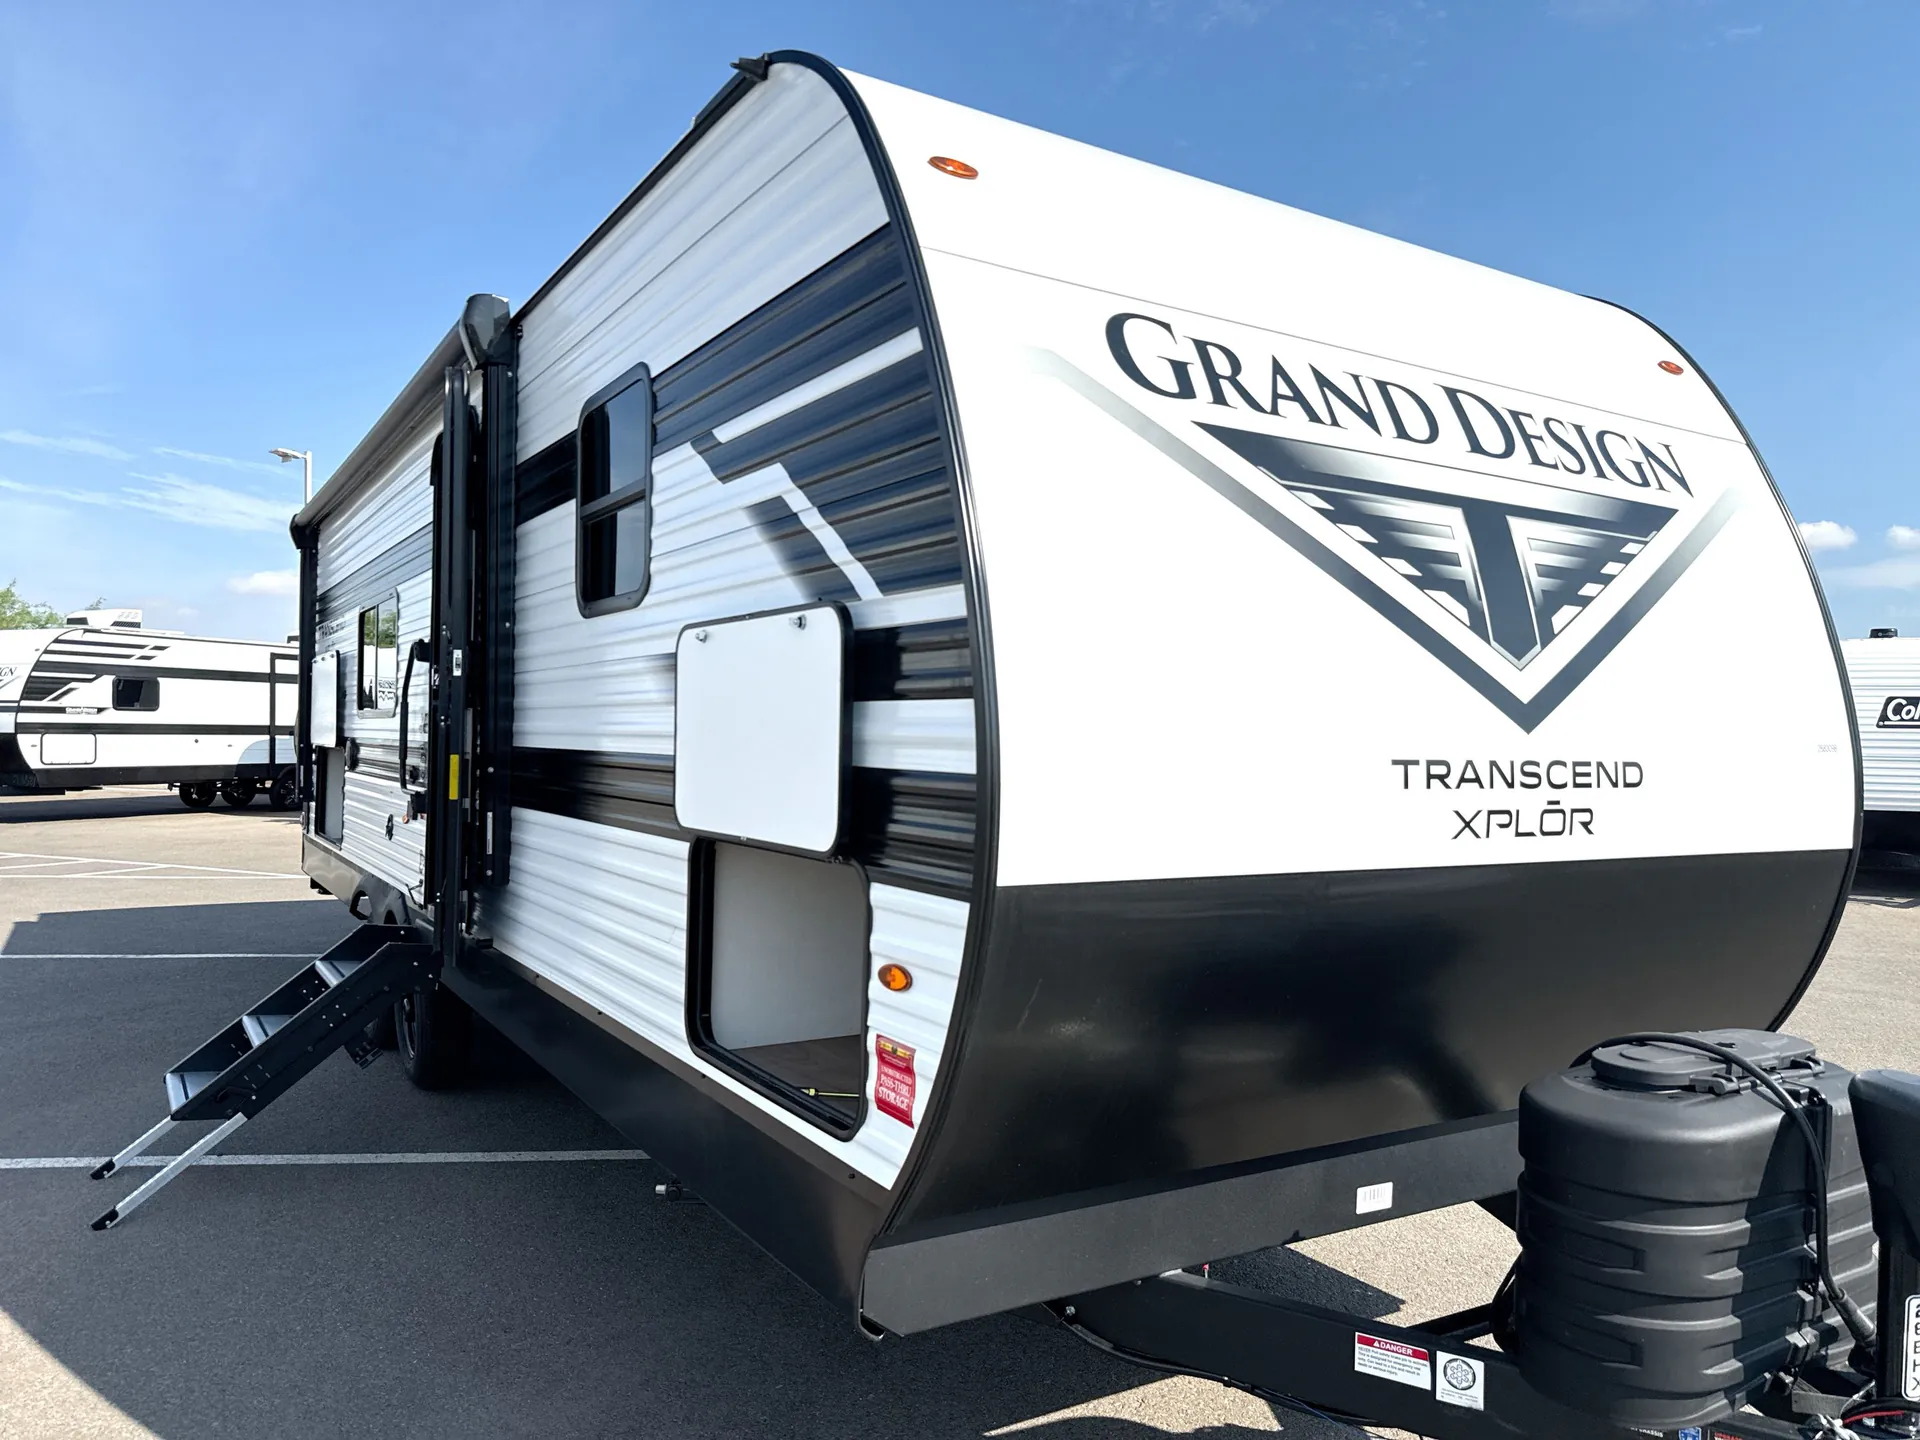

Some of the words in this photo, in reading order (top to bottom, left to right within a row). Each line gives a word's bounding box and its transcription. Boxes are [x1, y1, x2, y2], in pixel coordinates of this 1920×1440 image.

[1105, 312, 1439, 444] GRAND
[1433, 384, 1693, 497] DESIGN
[1391, 759, 1644, 791] TRANSCEND
[878, 1086, 910, 1111] STORAGE
[1380, 1341, 1413, 1356] DANGER
